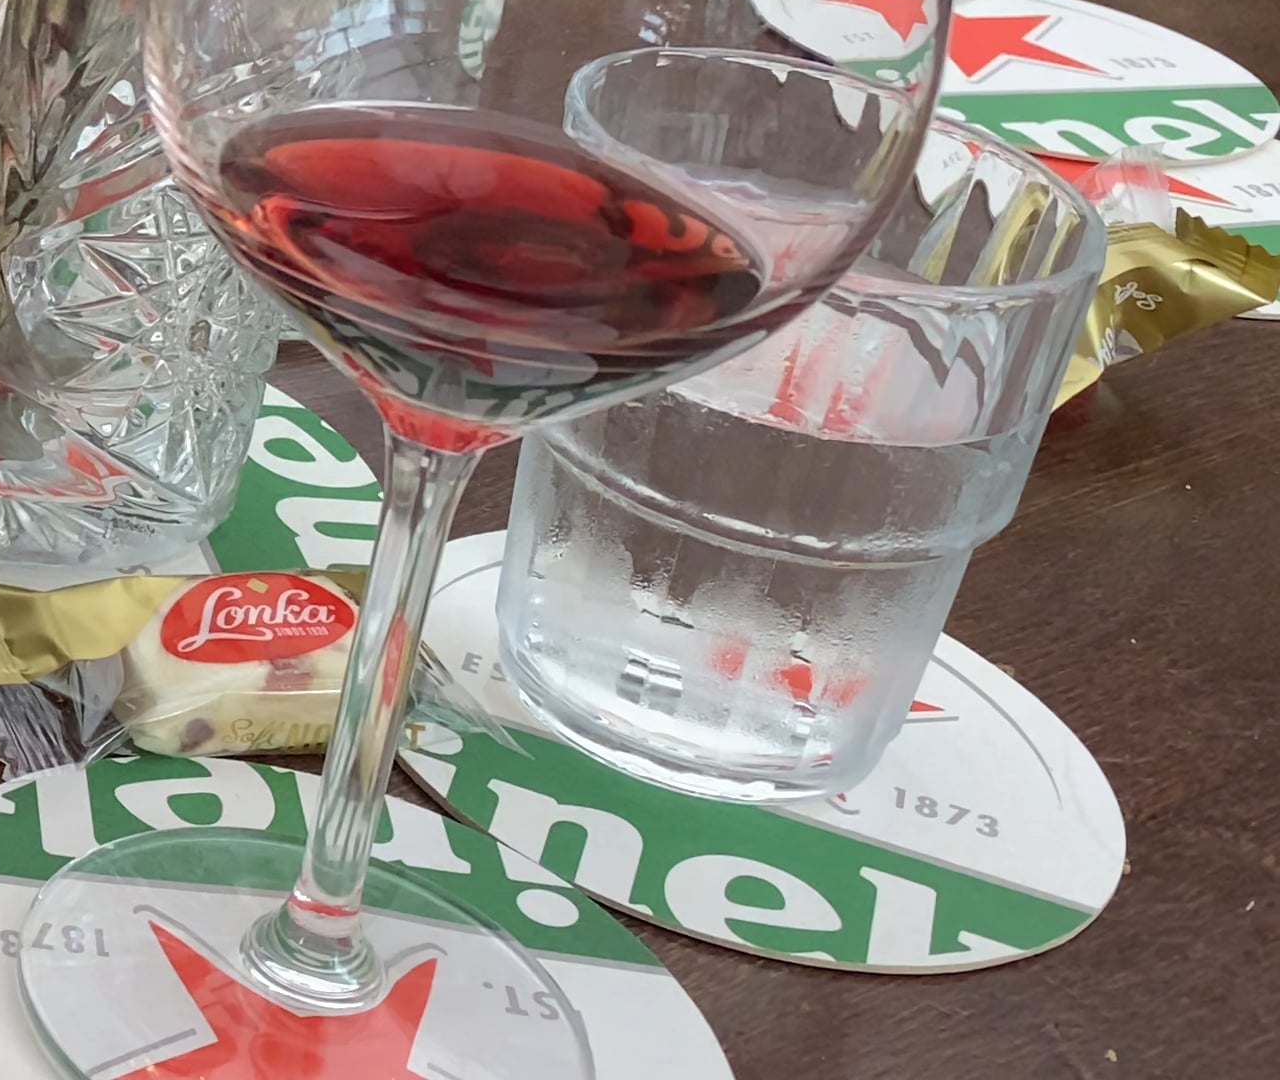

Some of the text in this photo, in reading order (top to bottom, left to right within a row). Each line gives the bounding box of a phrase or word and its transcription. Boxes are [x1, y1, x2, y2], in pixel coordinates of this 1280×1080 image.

[1109, 57, 1177, 69] 1873
[1233, 183, 1280, 198] 187
[177, 586, 335, 653] Lonka
[891, 786, 1002, 839] 1873
[0, 922, 110, 959] 1873
[482, 981, 565, 1020] ST.
